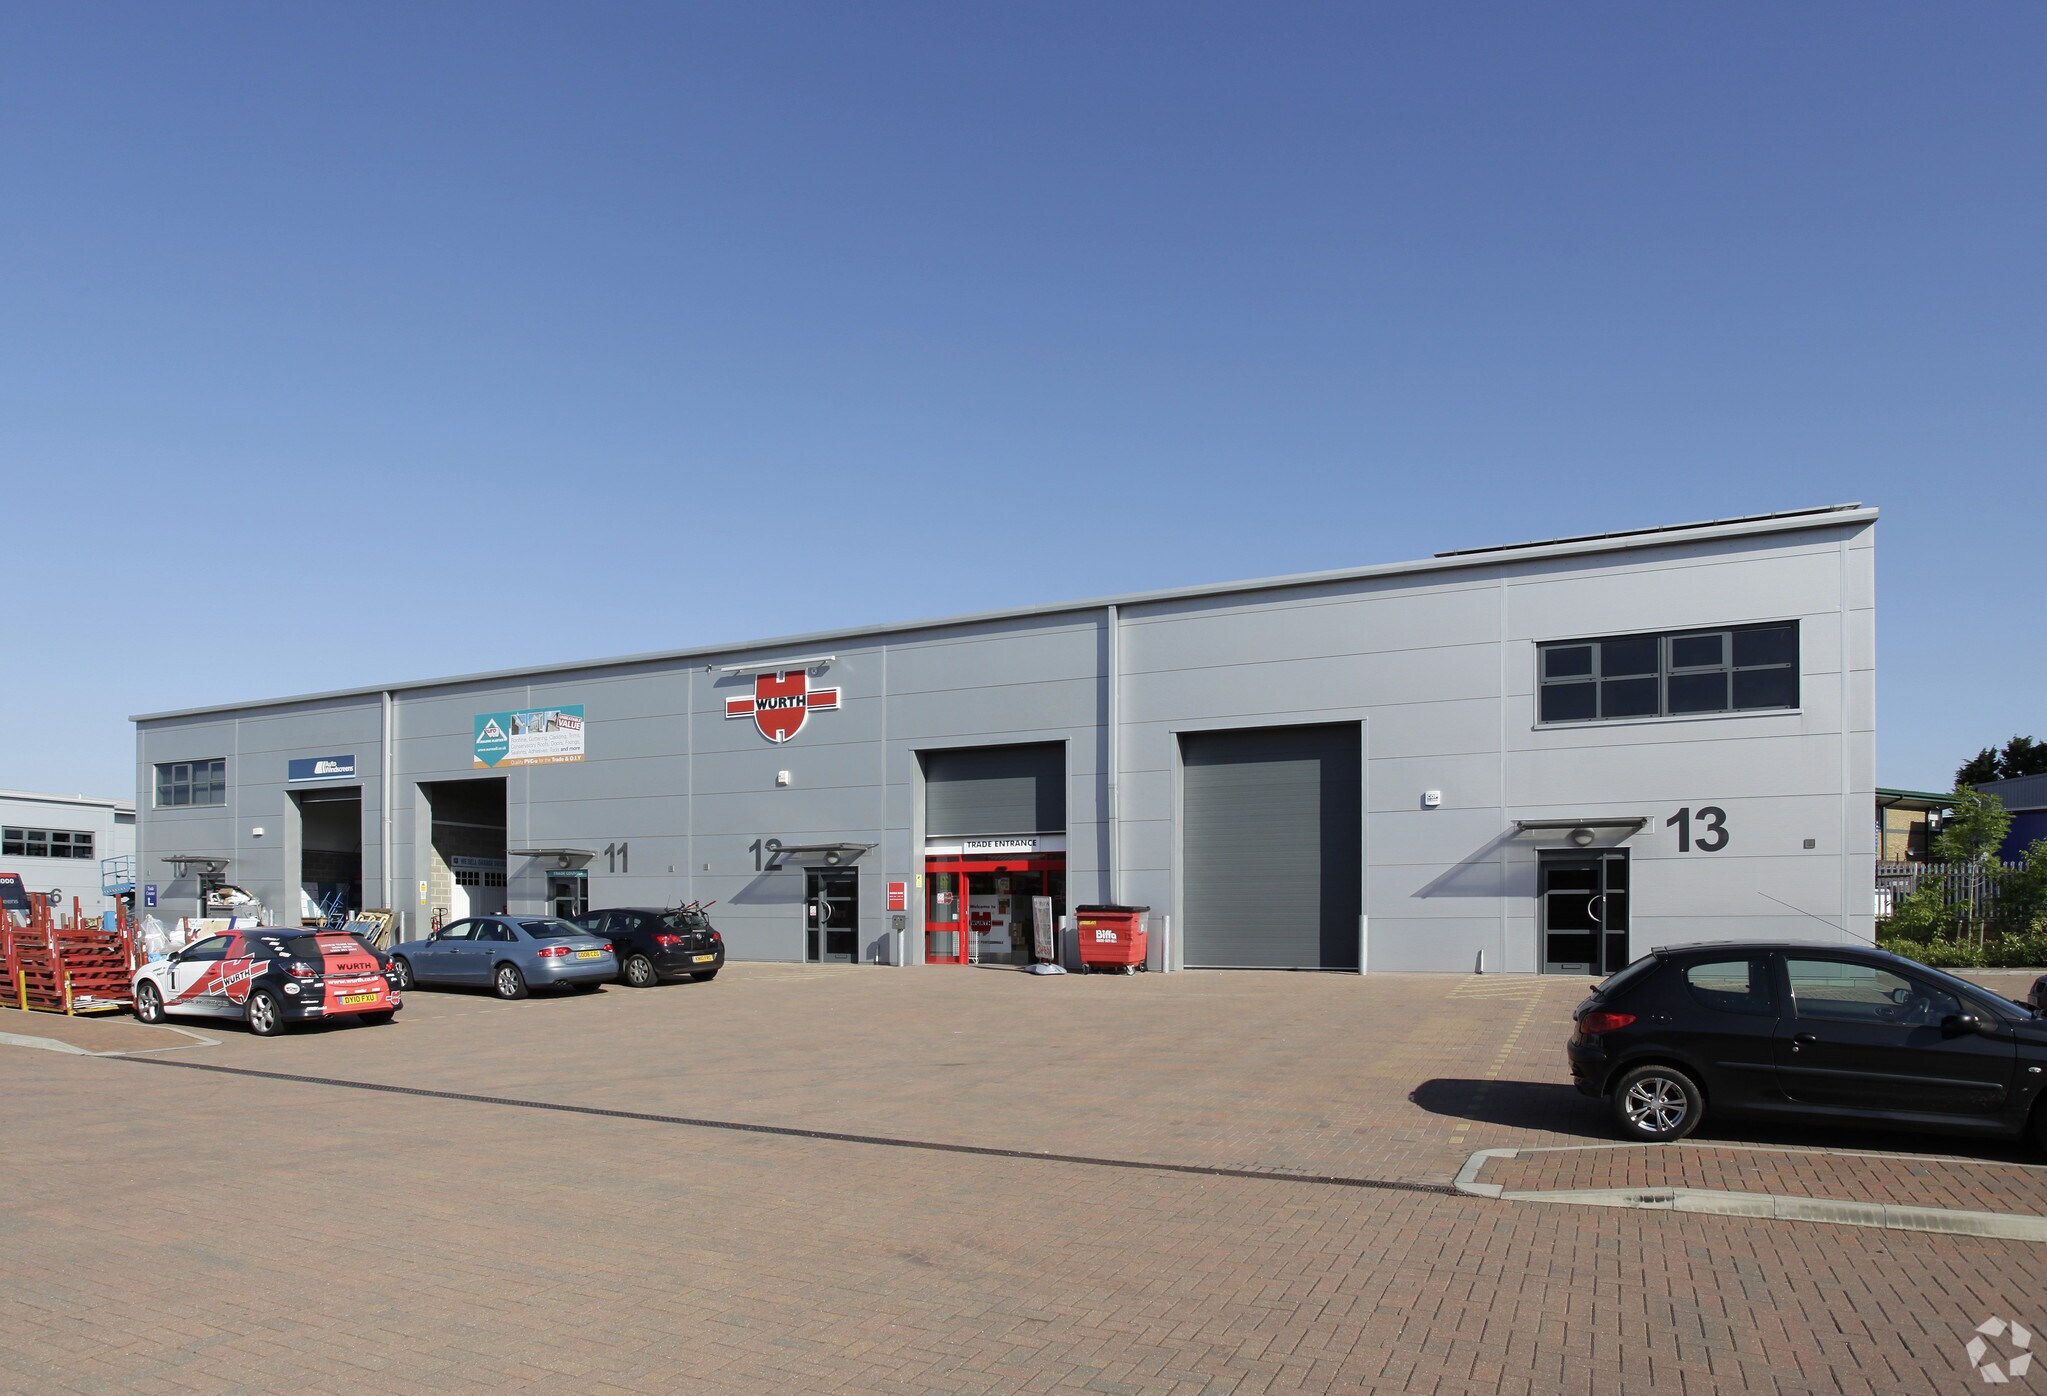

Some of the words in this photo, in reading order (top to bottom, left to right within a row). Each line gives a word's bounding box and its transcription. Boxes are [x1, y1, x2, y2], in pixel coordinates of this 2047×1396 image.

[559, 719, 581, 730] VALUE
[1666, 806, 1729, 852] 13
[967, 840, 992, 848] TRADE
[994, 839, 1037, 847] ENTRANCE
[604, 842, 628, 873] 11
[748, 838, 783, 871] 12
[50, 888, 62, 904] 6
[147, 897, 155, 906] L
[1095, 929, 1117, 939] Biffa
[327, 975, 379, 985] www.wurth.co.uk
[344, 995, 361, 1004] DY10
[361, 994, 375, 1002] FXU
